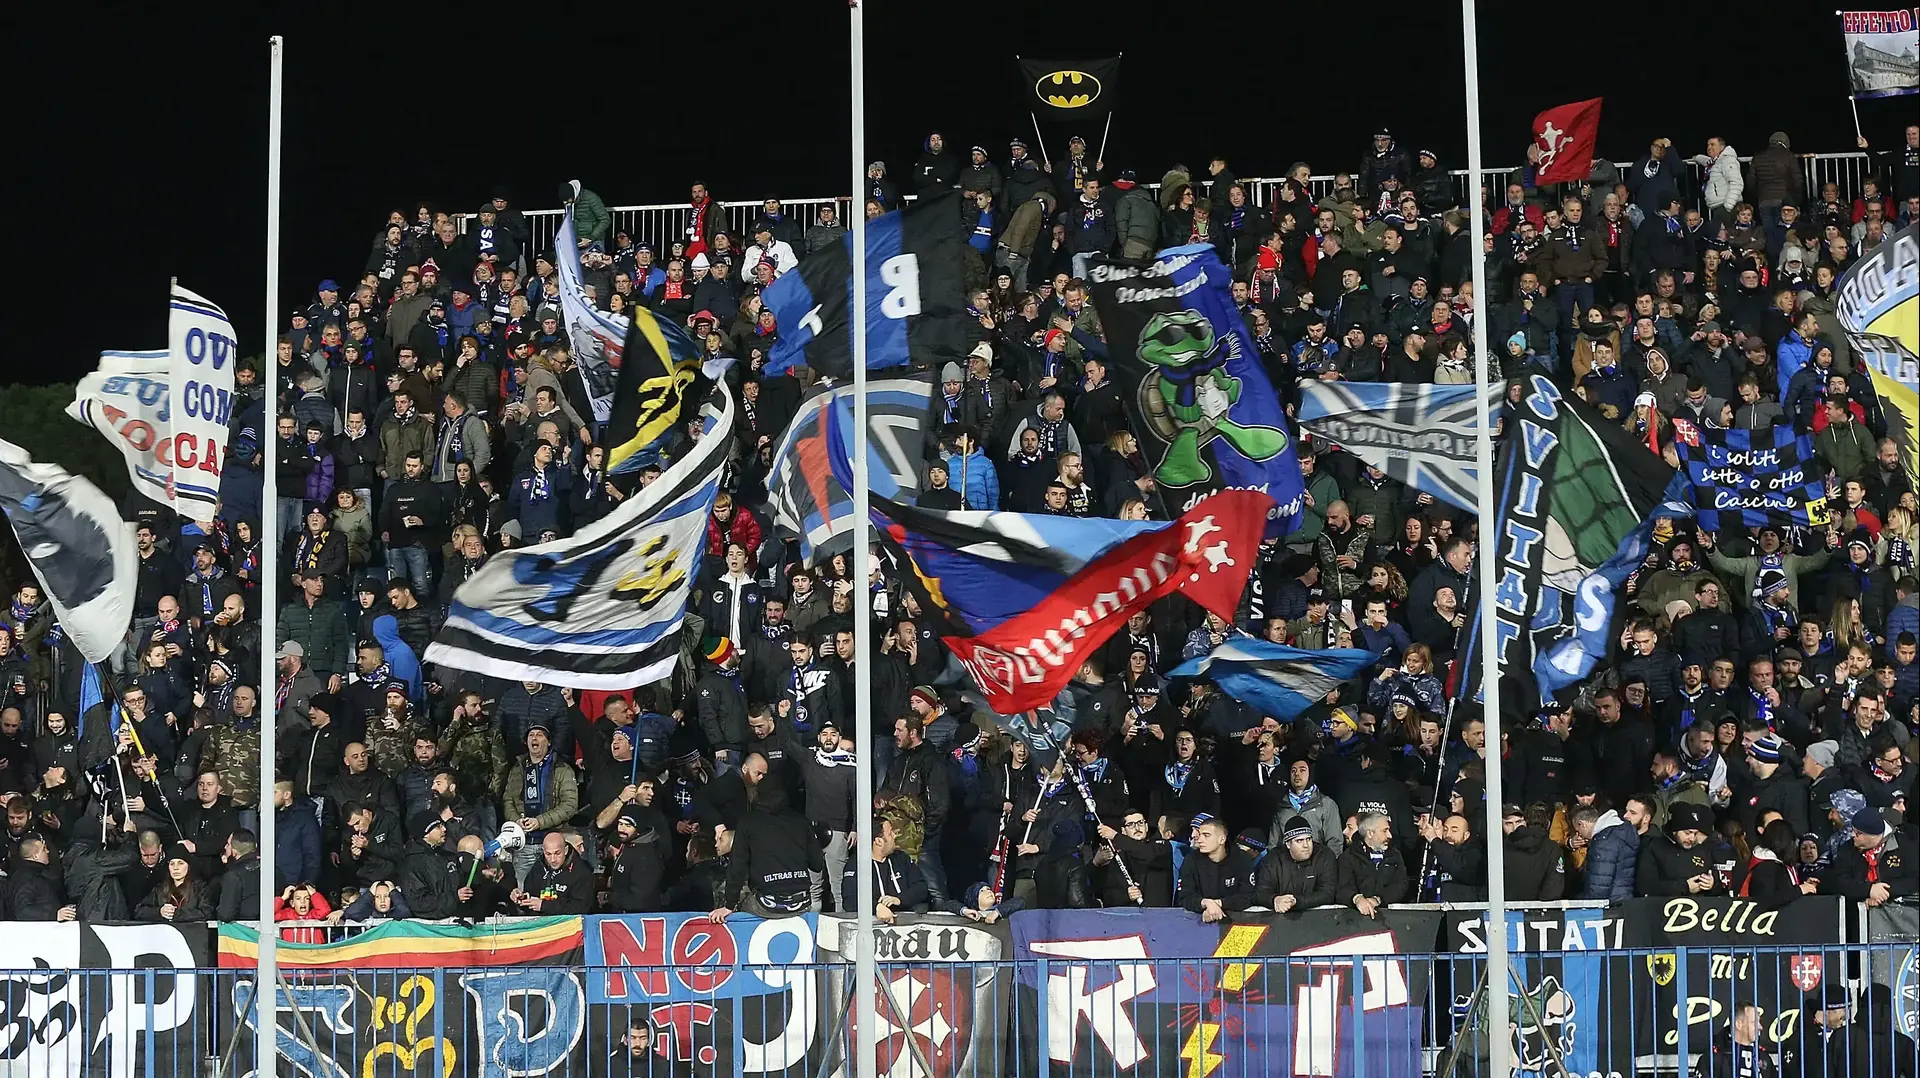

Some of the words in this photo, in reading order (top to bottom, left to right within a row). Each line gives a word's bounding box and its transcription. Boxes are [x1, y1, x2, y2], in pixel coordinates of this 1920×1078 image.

[1843, 9, 1911, 33] EFFETTO
[174, 433, 228, 477] CA
[1711, 444, 1721, 459] i
[1726, 449, 1781, 467] soliti
[1701, 468, 1744, 484] sette
[1750, 479, 1760, 490] o
[1769, 470, 1803, 490] otto
[1714, 491, 1797, 509] Cascine
[1367, 801, 1386, 809] VIOLA
[763, 871, 793, 883] ULTRAS
[1663, 897, 1779, 936] Bella
[1456, 917, 1625, 953] SITATI
